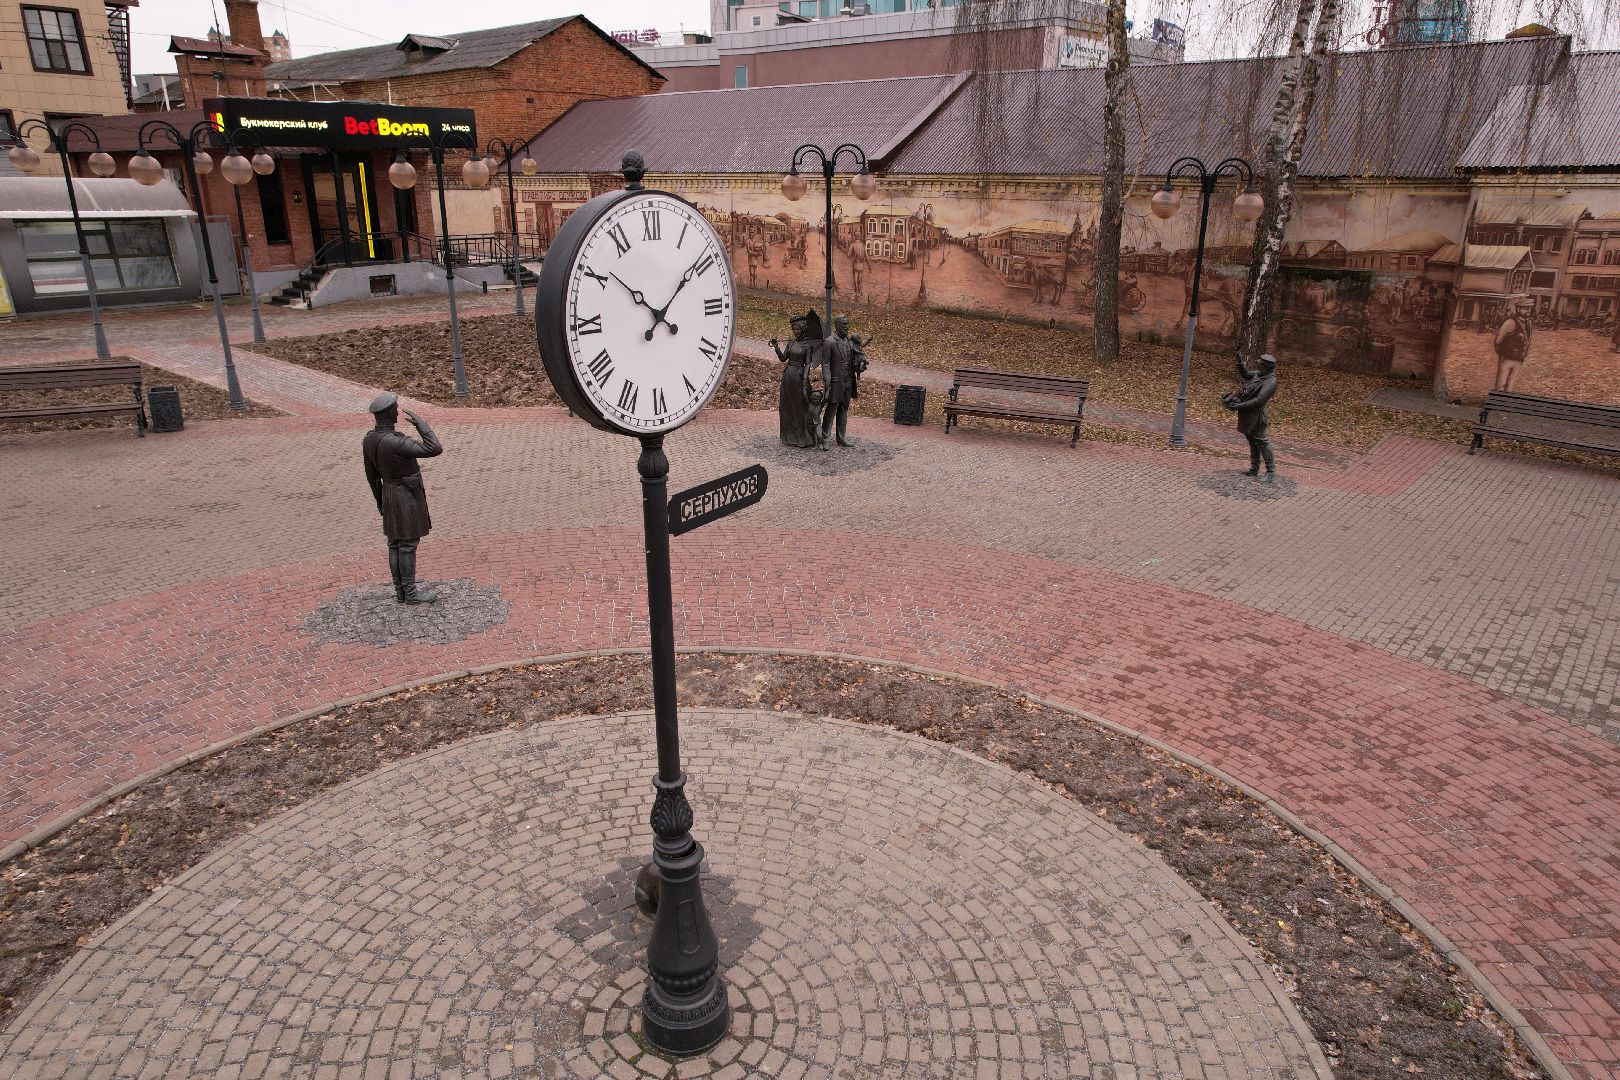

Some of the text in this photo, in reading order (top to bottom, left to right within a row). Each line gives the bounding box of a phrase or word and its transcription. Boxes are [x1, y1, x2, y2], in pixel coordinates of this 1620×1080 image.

[307, 120, 329, 131] клуб
[344, 116, 430, 136] BetBoom
[441, 123, 451, 132] 24
[642, 211, 661, 241] XII
[606, 222, 631, 259] XI
[584, 266, 608, 290] X
[694, 254, 715, 278] II
[704, 297, 723, 317] III
[577, 313, 602, 336] IX
[698, 336, 718, 362] IV
[587, 348, 615, 390] VIII
[617, 378, 638, 415] VII
[681, 373, 697, 398] V
[652, 387, 668, 415] VI
[680, 474, 758, 522] СЕРПУХОВ
